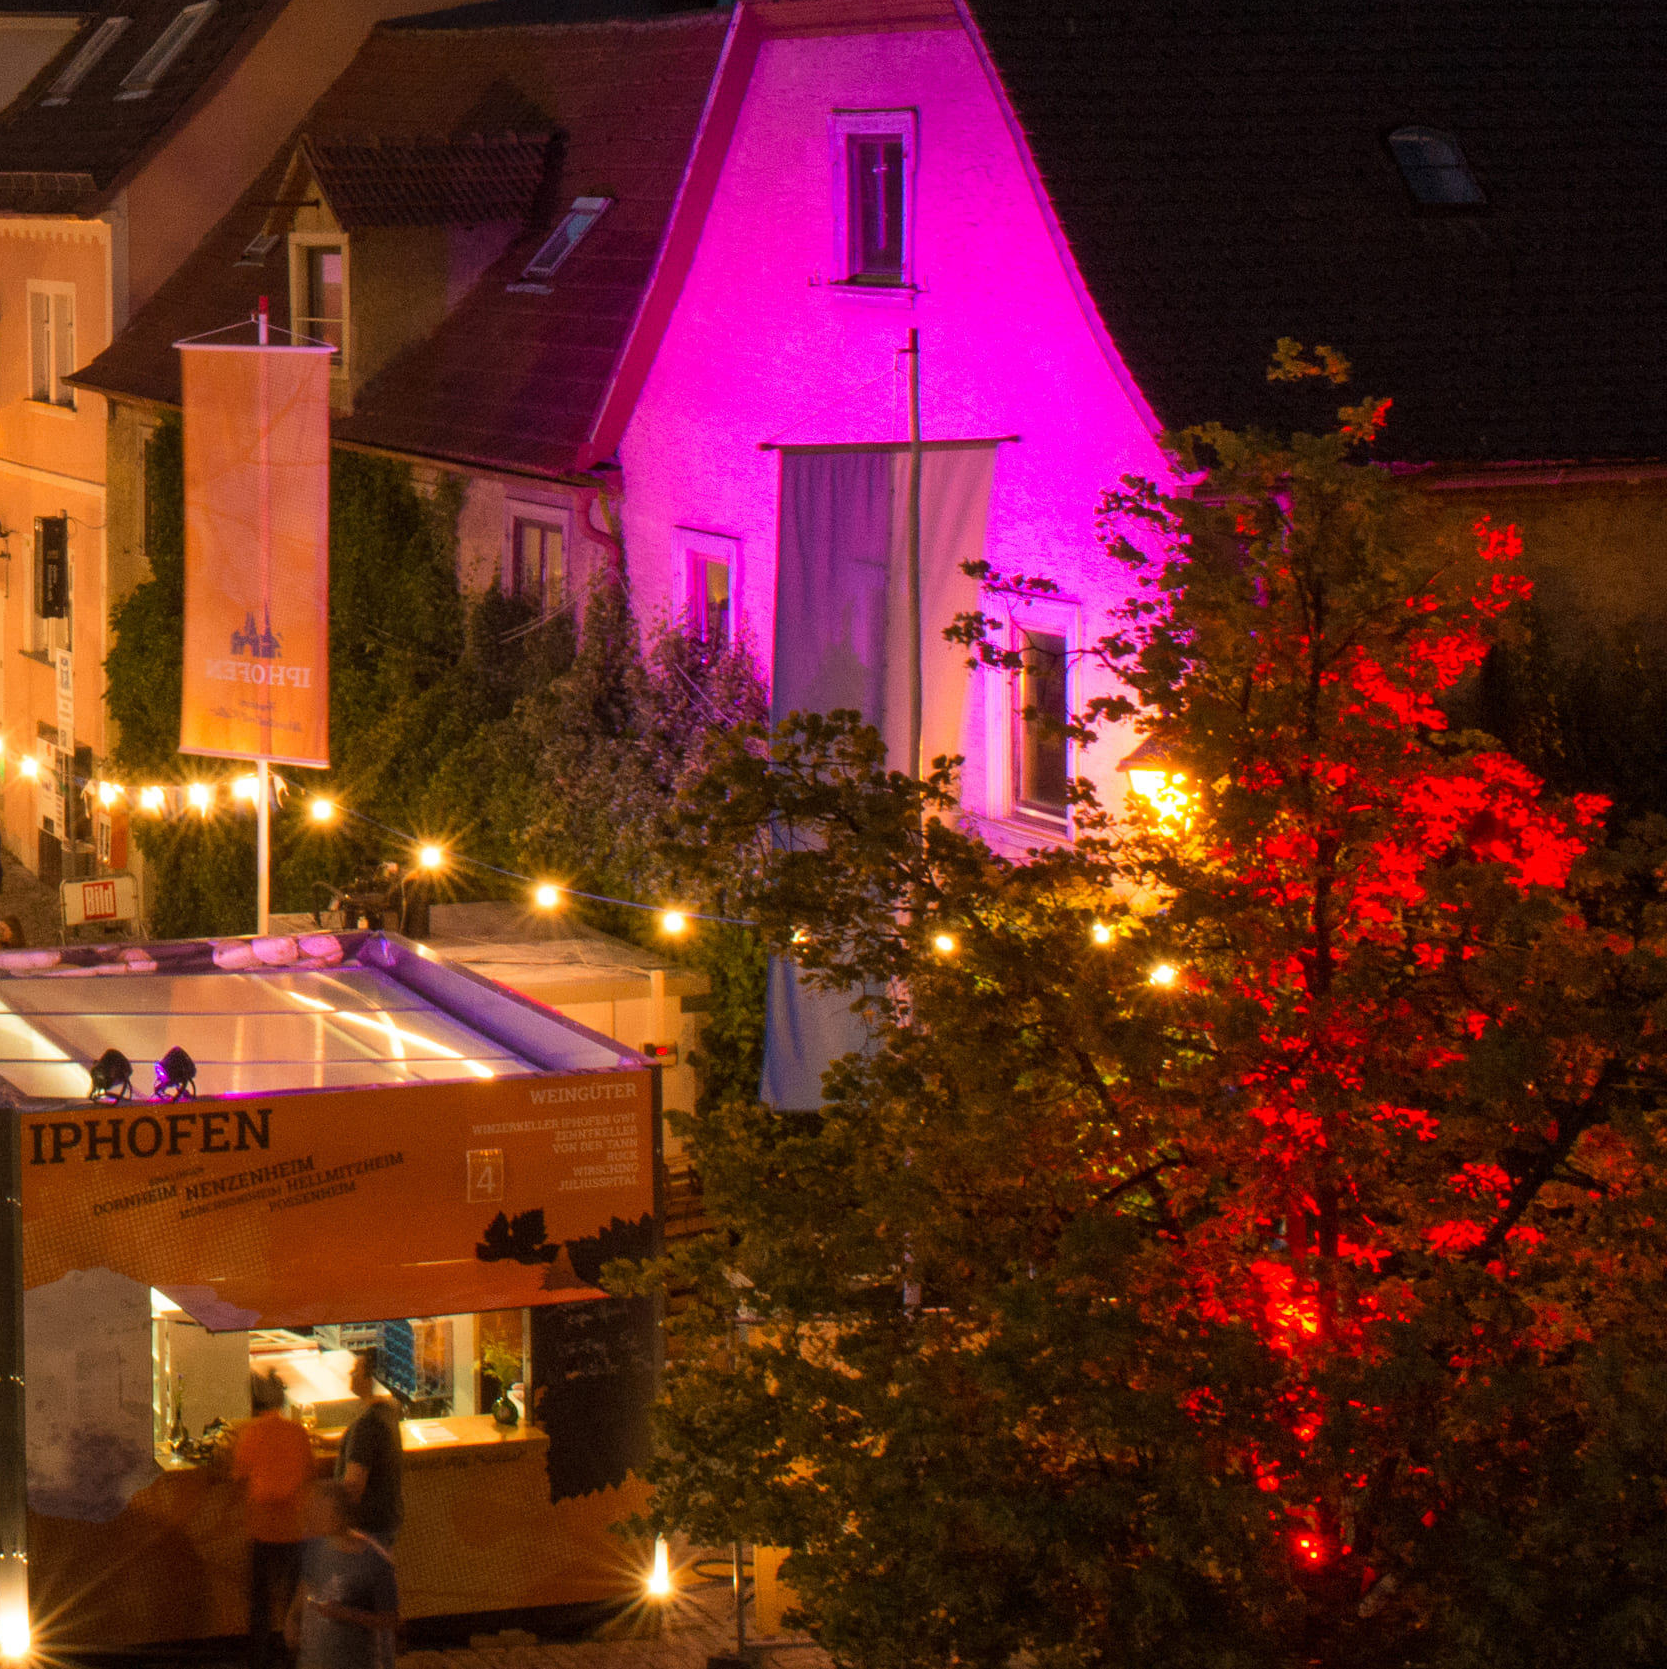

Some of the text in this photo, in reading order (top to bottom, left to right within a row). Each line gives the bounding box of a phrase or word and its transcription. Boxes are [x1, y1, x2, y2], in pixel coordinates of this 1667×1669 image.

[84, 883, 115, 916] Bild
[530, 1082, 637, 1105] WEINGÜTER
[472, 1119, 558, 1135] WINZERKELLER
[561, 1115, 610, 1129] IPHOFEN
[555, 1125, 638, 1141] ZEHNTKELLER
[29, 1109, 273, 1165] IPHOFEN
[552, 1138, 638, 1154] VON DER TANN
[606, 1151, 638, 1162] RUCK
[287, 1152, 404, 1193] HELLMITZHEIM
[475, 1165, 496, 1194] 4
[572, 1163, 639, 1177] WIRSCHING
[93, 1155, 315, 1217] DORNHEIM NENZENHEIM
[557, 1176, 638, 1192] JULIUSSPITAL
[269, 1181, 357, 1213] POSSENHEIM
